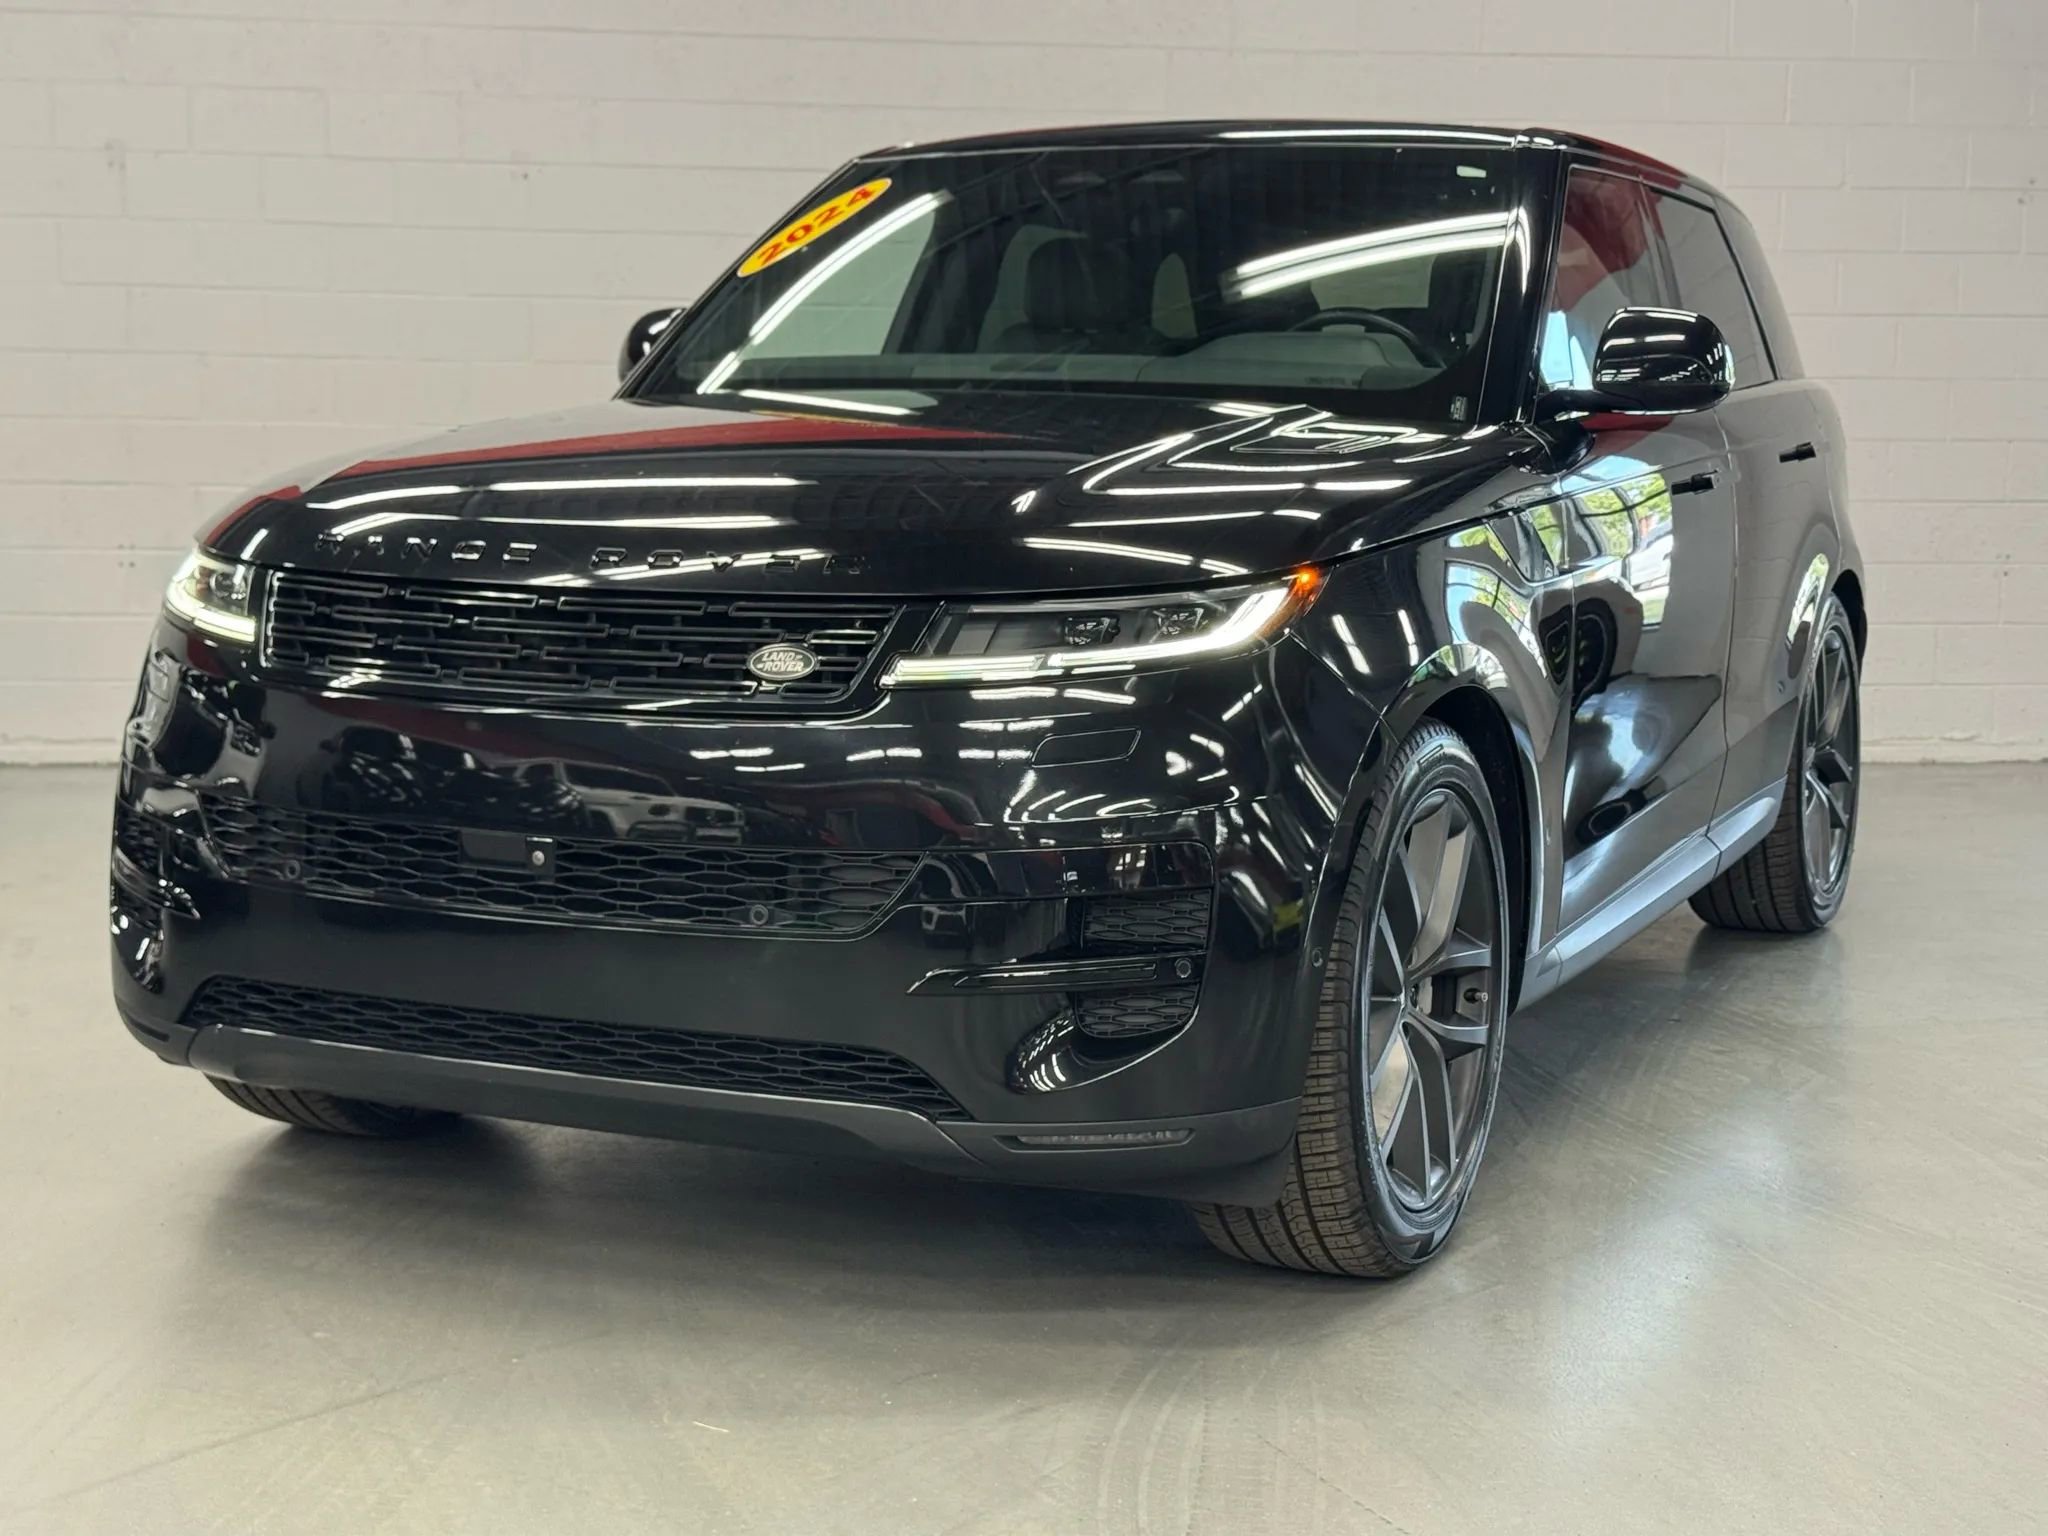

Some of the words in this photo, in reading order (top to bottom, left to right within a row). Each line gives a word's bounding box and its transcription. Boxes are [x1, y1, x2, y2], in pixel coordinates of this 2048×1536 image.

[757, 187, 877, 266] 2024
[590, 546, 871, 575] ROVER
[762, 651, 795, 662] LAND
[763, 661, 805, 672] ROVER
